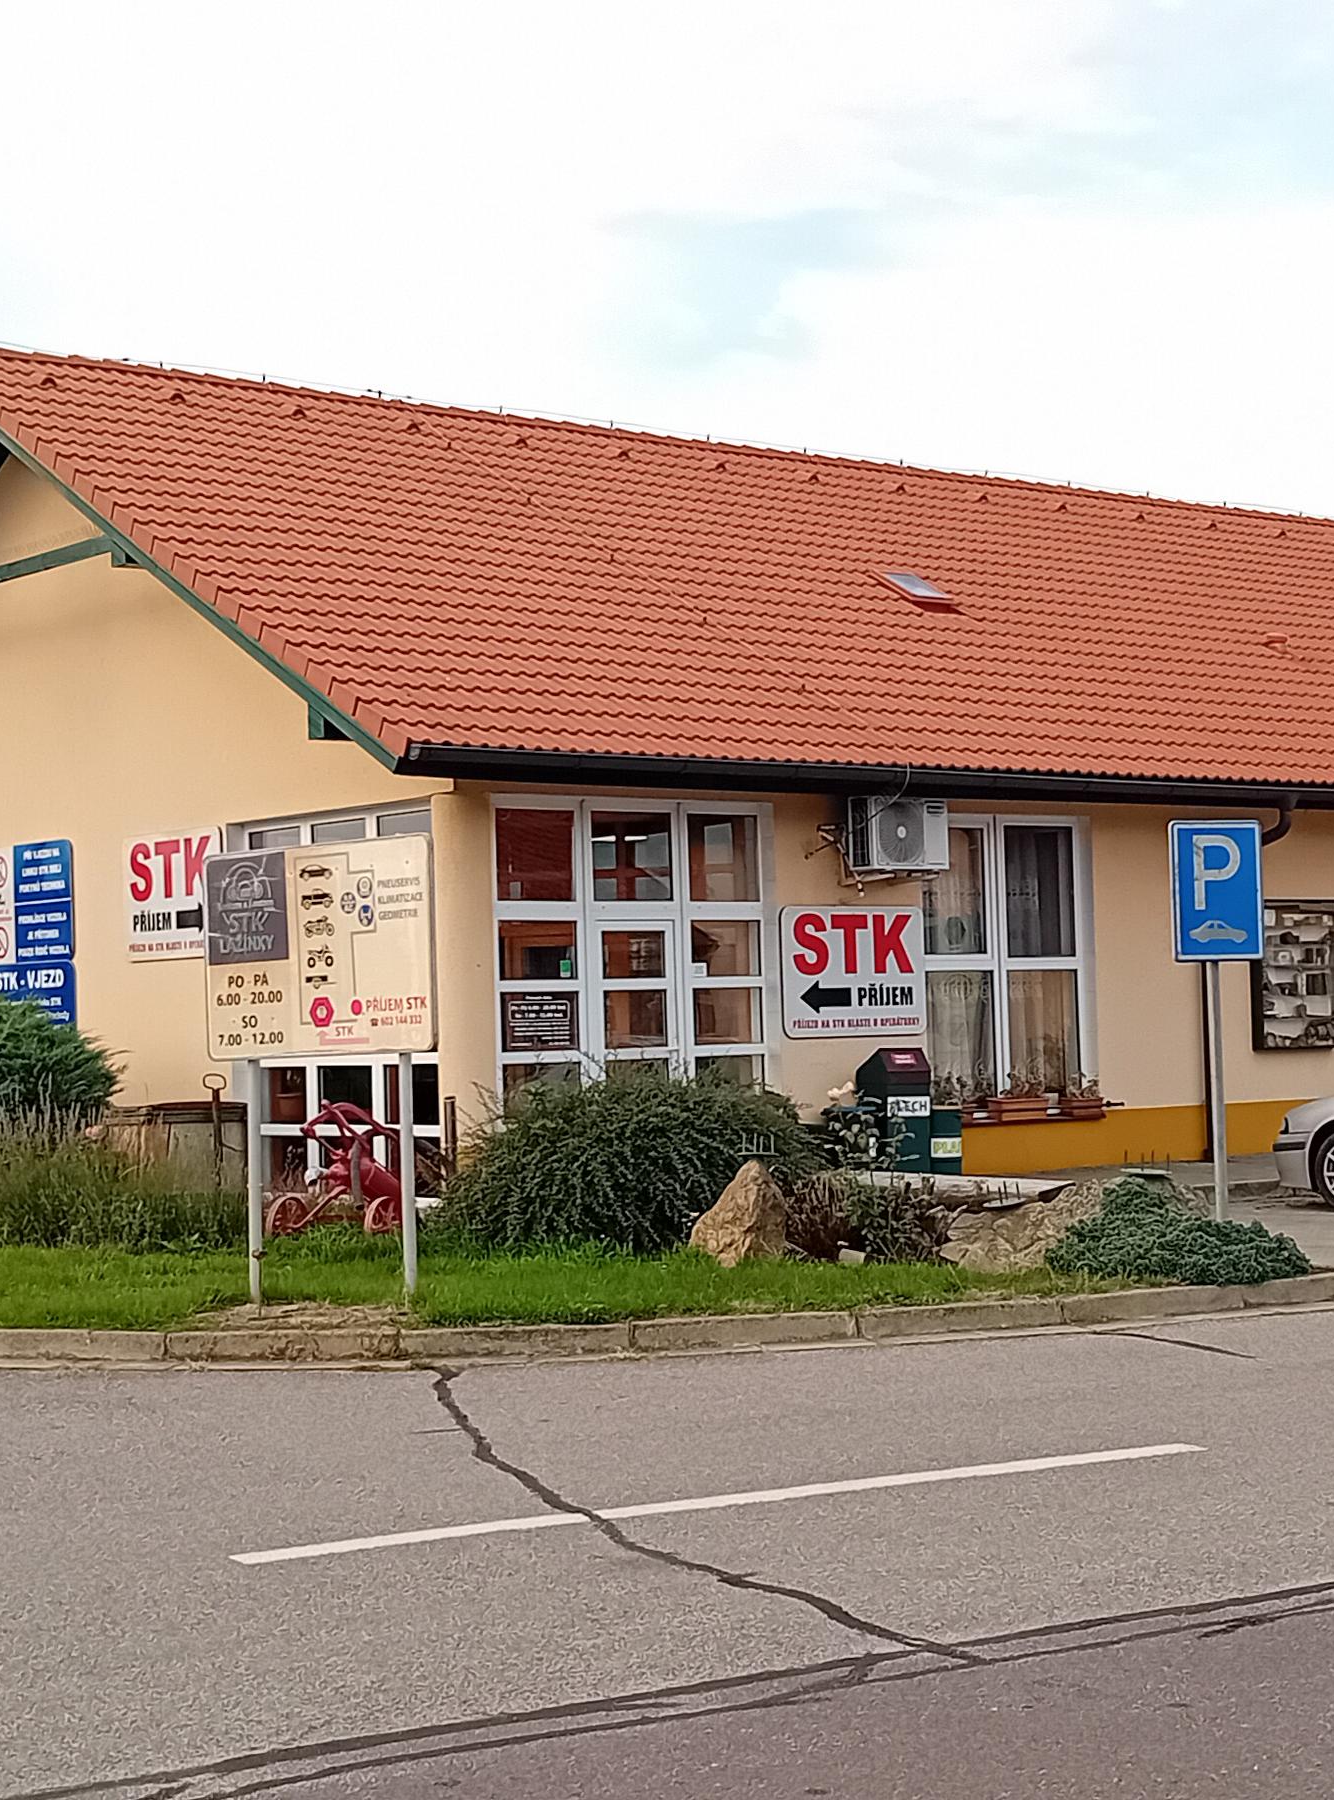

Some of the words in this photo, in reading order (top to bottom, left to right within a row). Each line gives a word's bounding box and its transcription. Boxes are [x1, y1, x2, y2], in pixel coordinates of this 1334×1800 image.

[130, 835, 211, 902] STK
[1192, 834, 1241, 910] P
[377, 876, 420, 888] PNEUSERVIS
[377, 892, 423, 904] KLIMATIZACE
[133, 910, 172, 932] PŘÍJEM
[229, 912, 265, 933] STK
[378, 908, 418, 921] GEOMETRIE
[792, 913, 915, 976] STK
[26, 969, 64, 989] VJEZD
[228, 975, 245, 989] PO
[253, 971, 269, 986] PÁ
[216, 992, 241, 1006] 6.00
[250, 990, 283, 1005] 20.00
[857, 983, 914, 1007] PŘÍJEM
[366, 996, 403, 1012] PŘÍJEM
[406, 997, 427, 1010] STK
[241, 1015, 258, 1029] SO
[821, 1019, 830, 1028] NA
[833, 1019, 845, 1028] STK
[218, 1033, 242, 1046] 7.00
[252, 1031, 284, 1045] 12.00
[335, 1026, 354, 1037] STK
